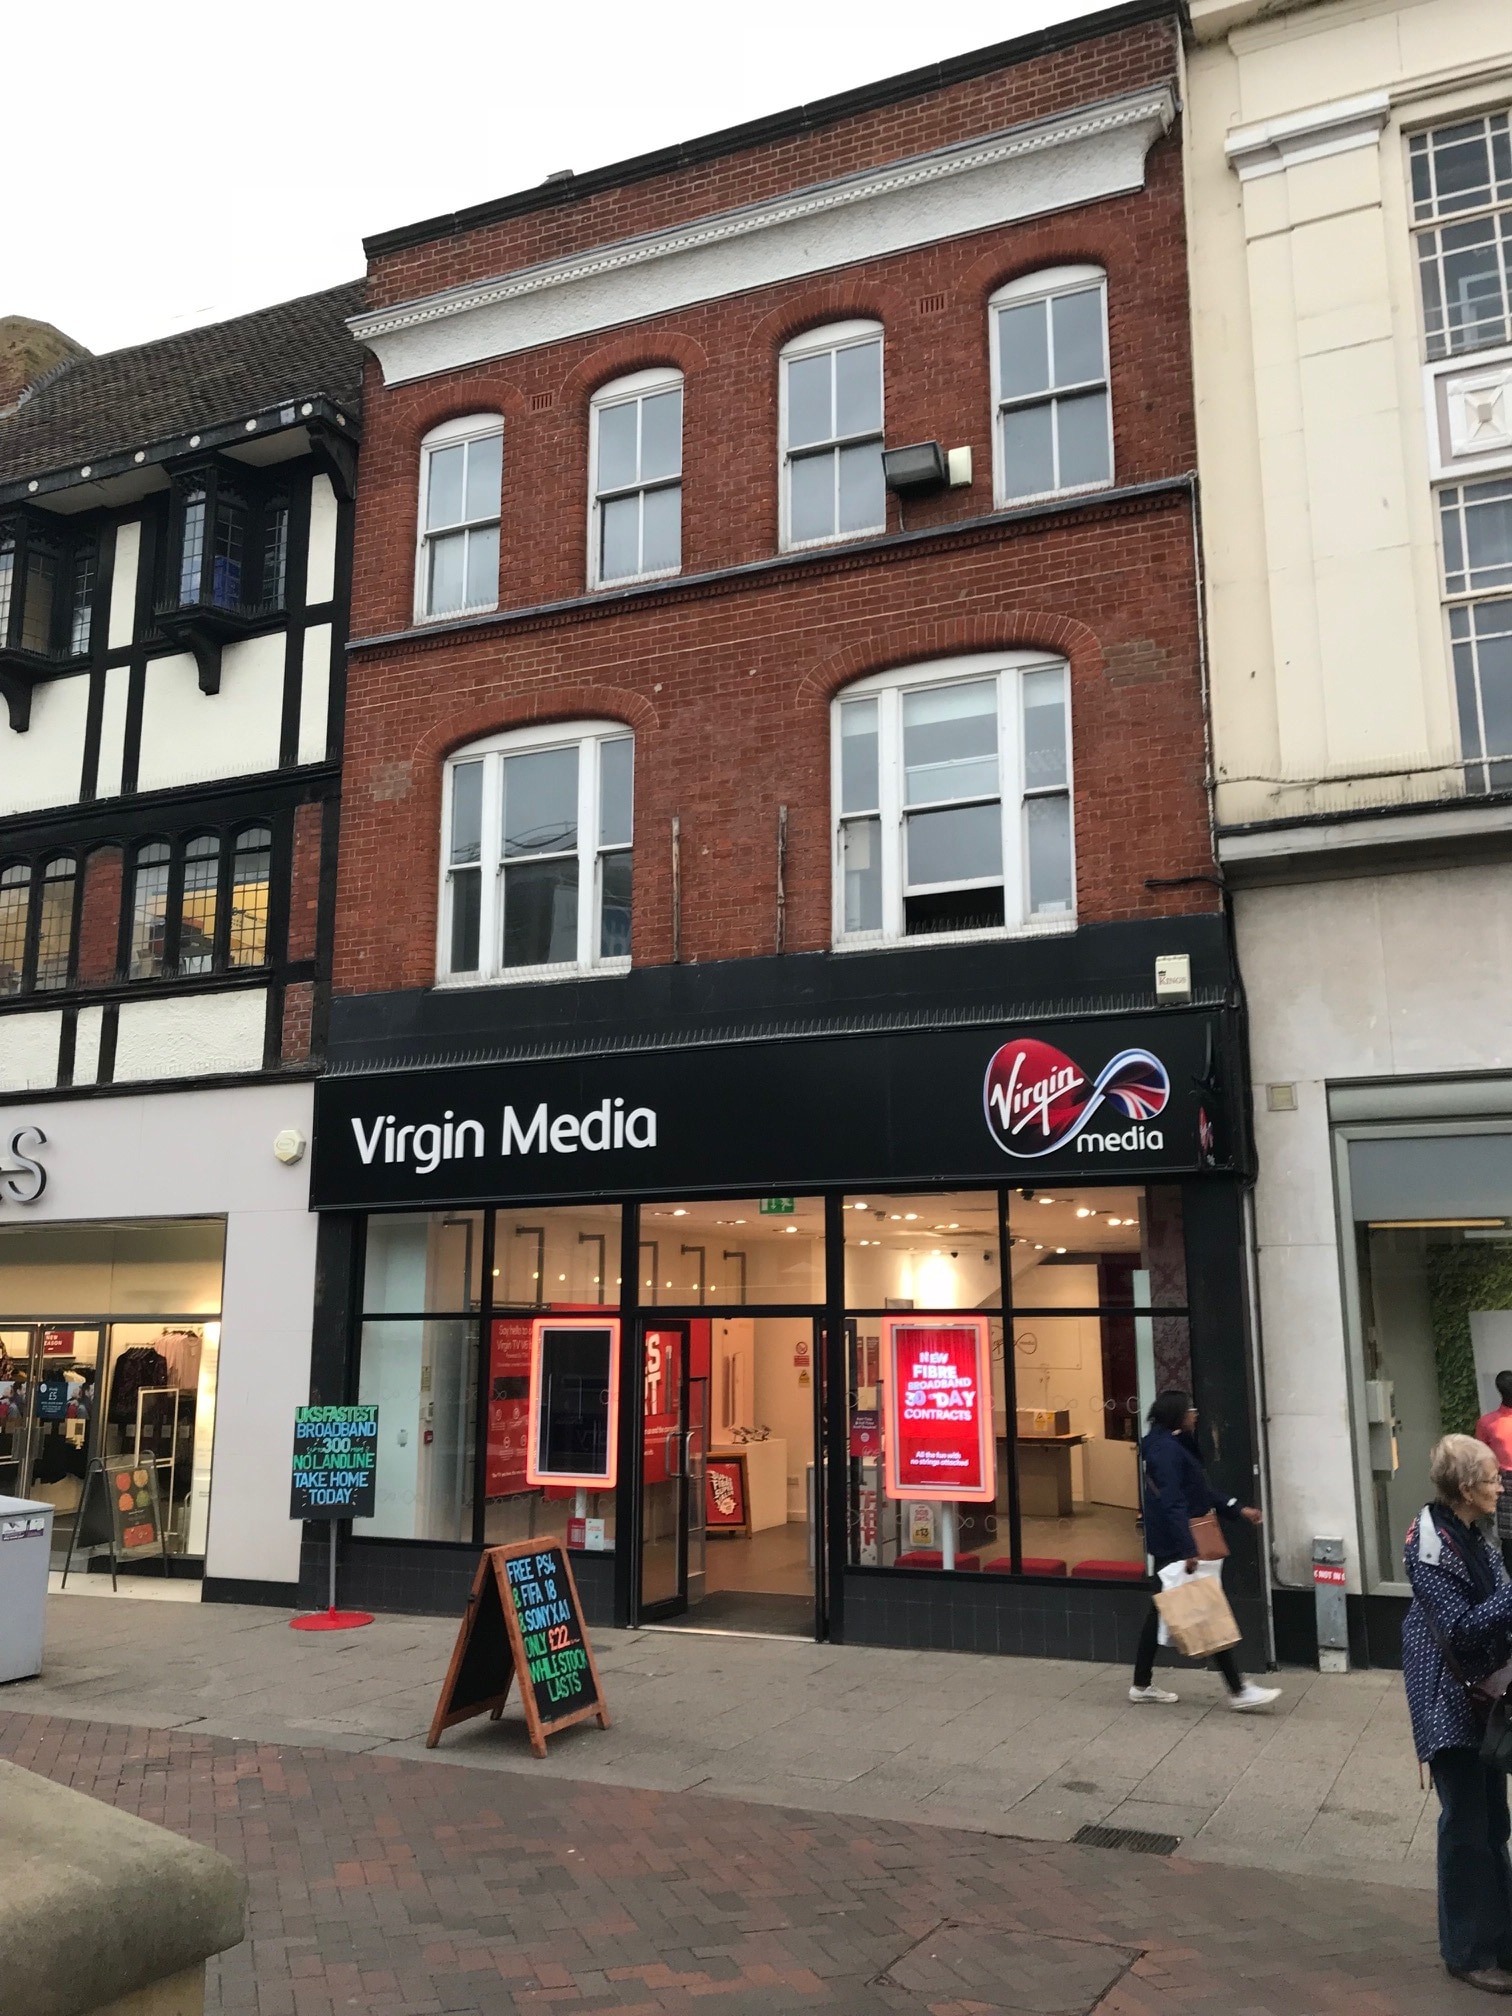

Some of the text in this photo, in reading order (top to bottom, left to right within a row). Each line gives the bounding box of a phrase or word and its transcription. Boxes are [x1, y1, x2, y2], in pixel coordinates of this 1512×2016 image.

[990, 1052, 1085, 1136] Virgin
[351, 1097, 657, 1174] Virgin Media
[1077, 1126, 1164, 1153] media
[0, 1125, 47, 1203] S
[920, 1352, 948, 1363] NEW
[912, 1365, 957, 1378] FIBRE
[908, 1378, 972, 1390] BROADBAND
[904, 1408, 972, 1421] CONTRACTS
[297, 1421, 376, 1438] BROADBAND
[323, 1438, 351, 1453] 300
[294, 1453, 375, 1470] NO LANDLINE
[919, 1459, 940, 1467] strings
[294, 1472, 369, 1488] TAKE HOME
[309, 1488, 353, 1505] TODAY
[506, 1553, 556, 1584] FREE PS4
[512, 1579, 557, 1608] & FIFA 18
[518, 1612, 527, 1633] &
[525, 1604, 551, 1632] SONY
[524, 1625, 571, 1659] ONLY £22
[558, 1649, 588, 1674] STOCK
[546, 1672, 582, 1702] LASTS
